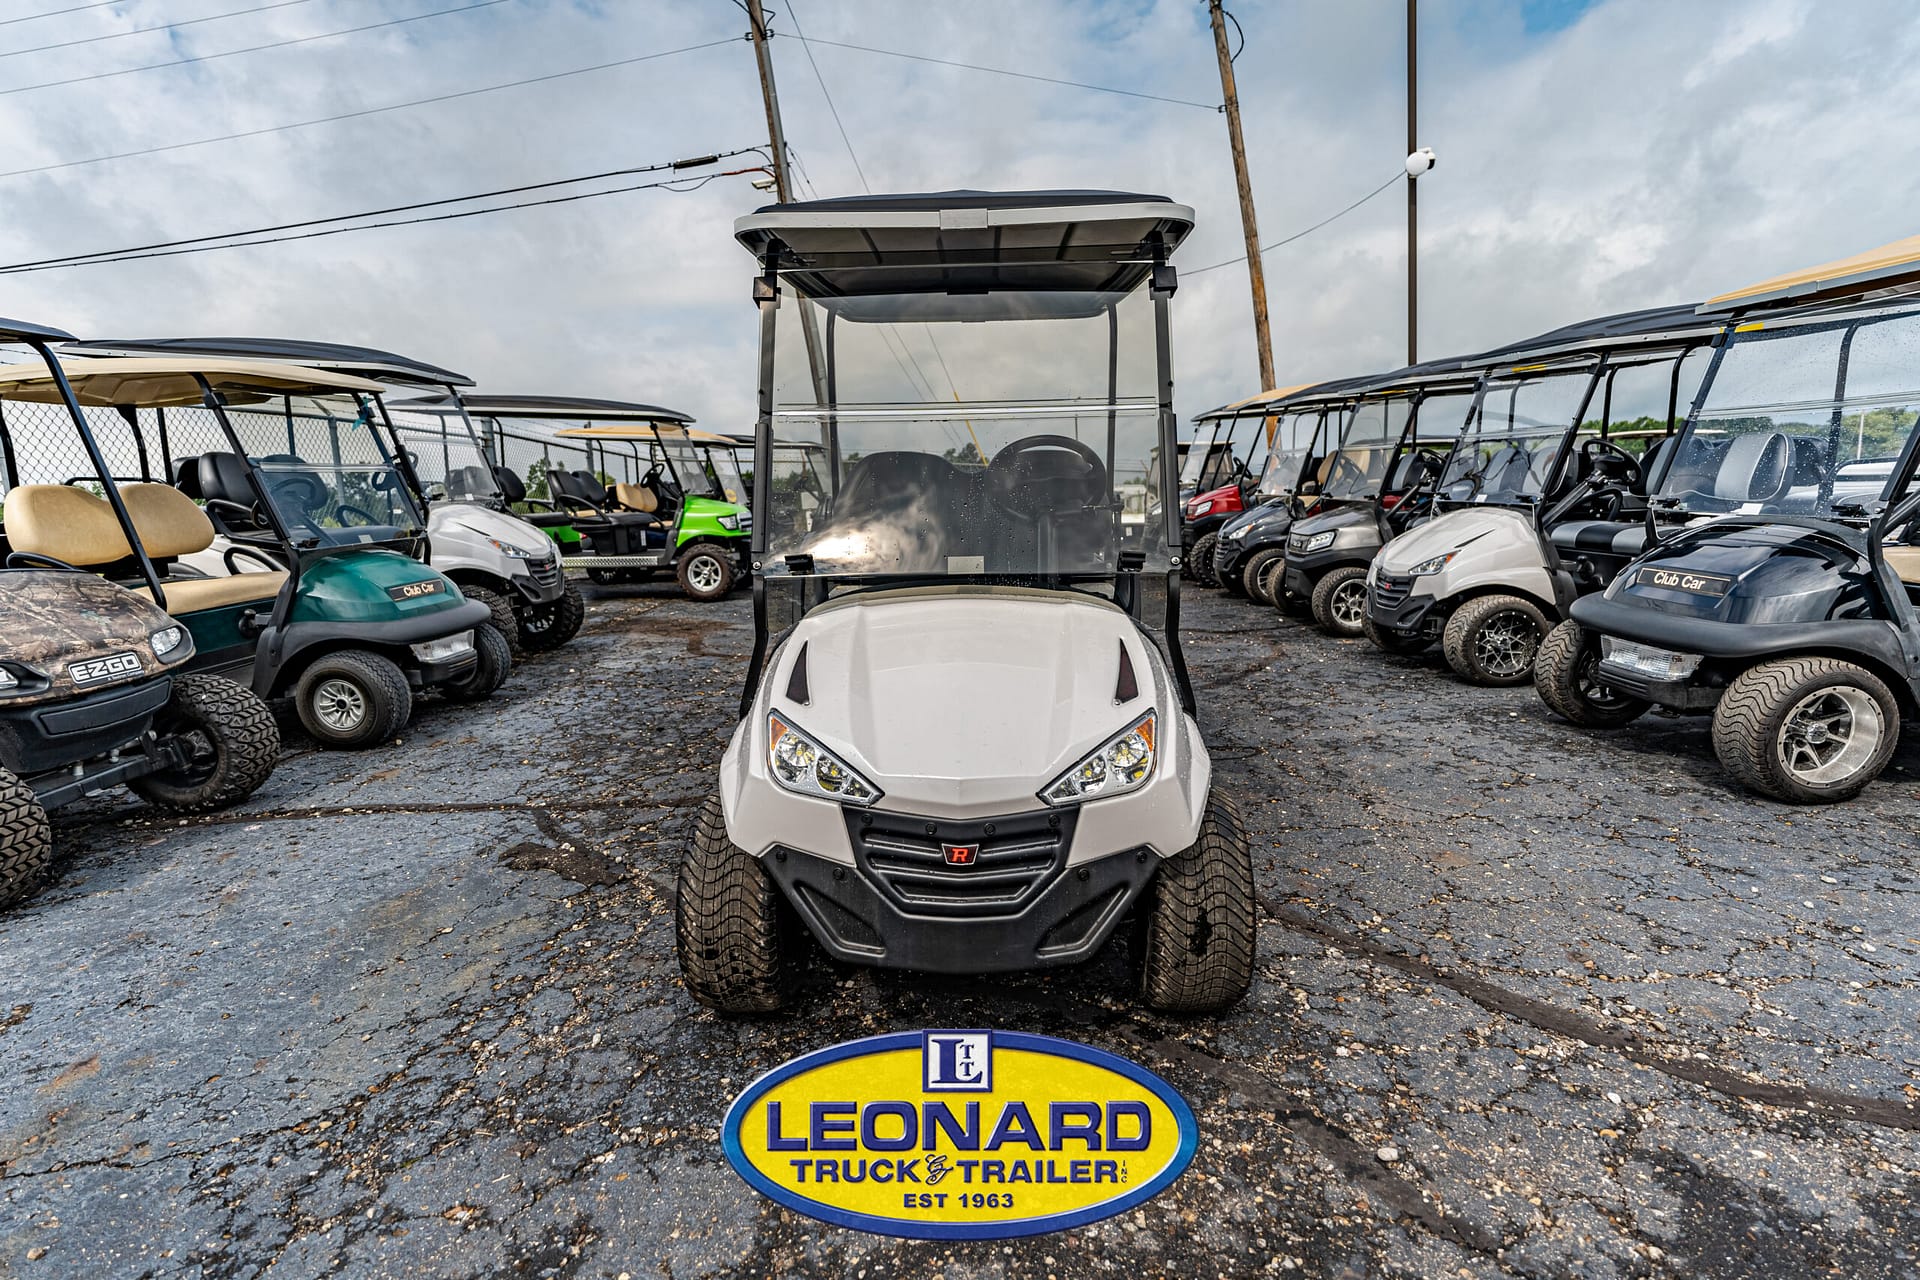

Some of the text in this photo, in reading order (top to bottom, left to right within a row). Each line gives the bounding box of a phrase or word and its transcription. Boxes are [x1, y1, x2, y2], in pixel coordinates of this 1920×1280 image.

[1654, 571, 1706, 590] Club Car
[403, 583, 435, 597] Club Car
[951, 847, 969, 862] R
